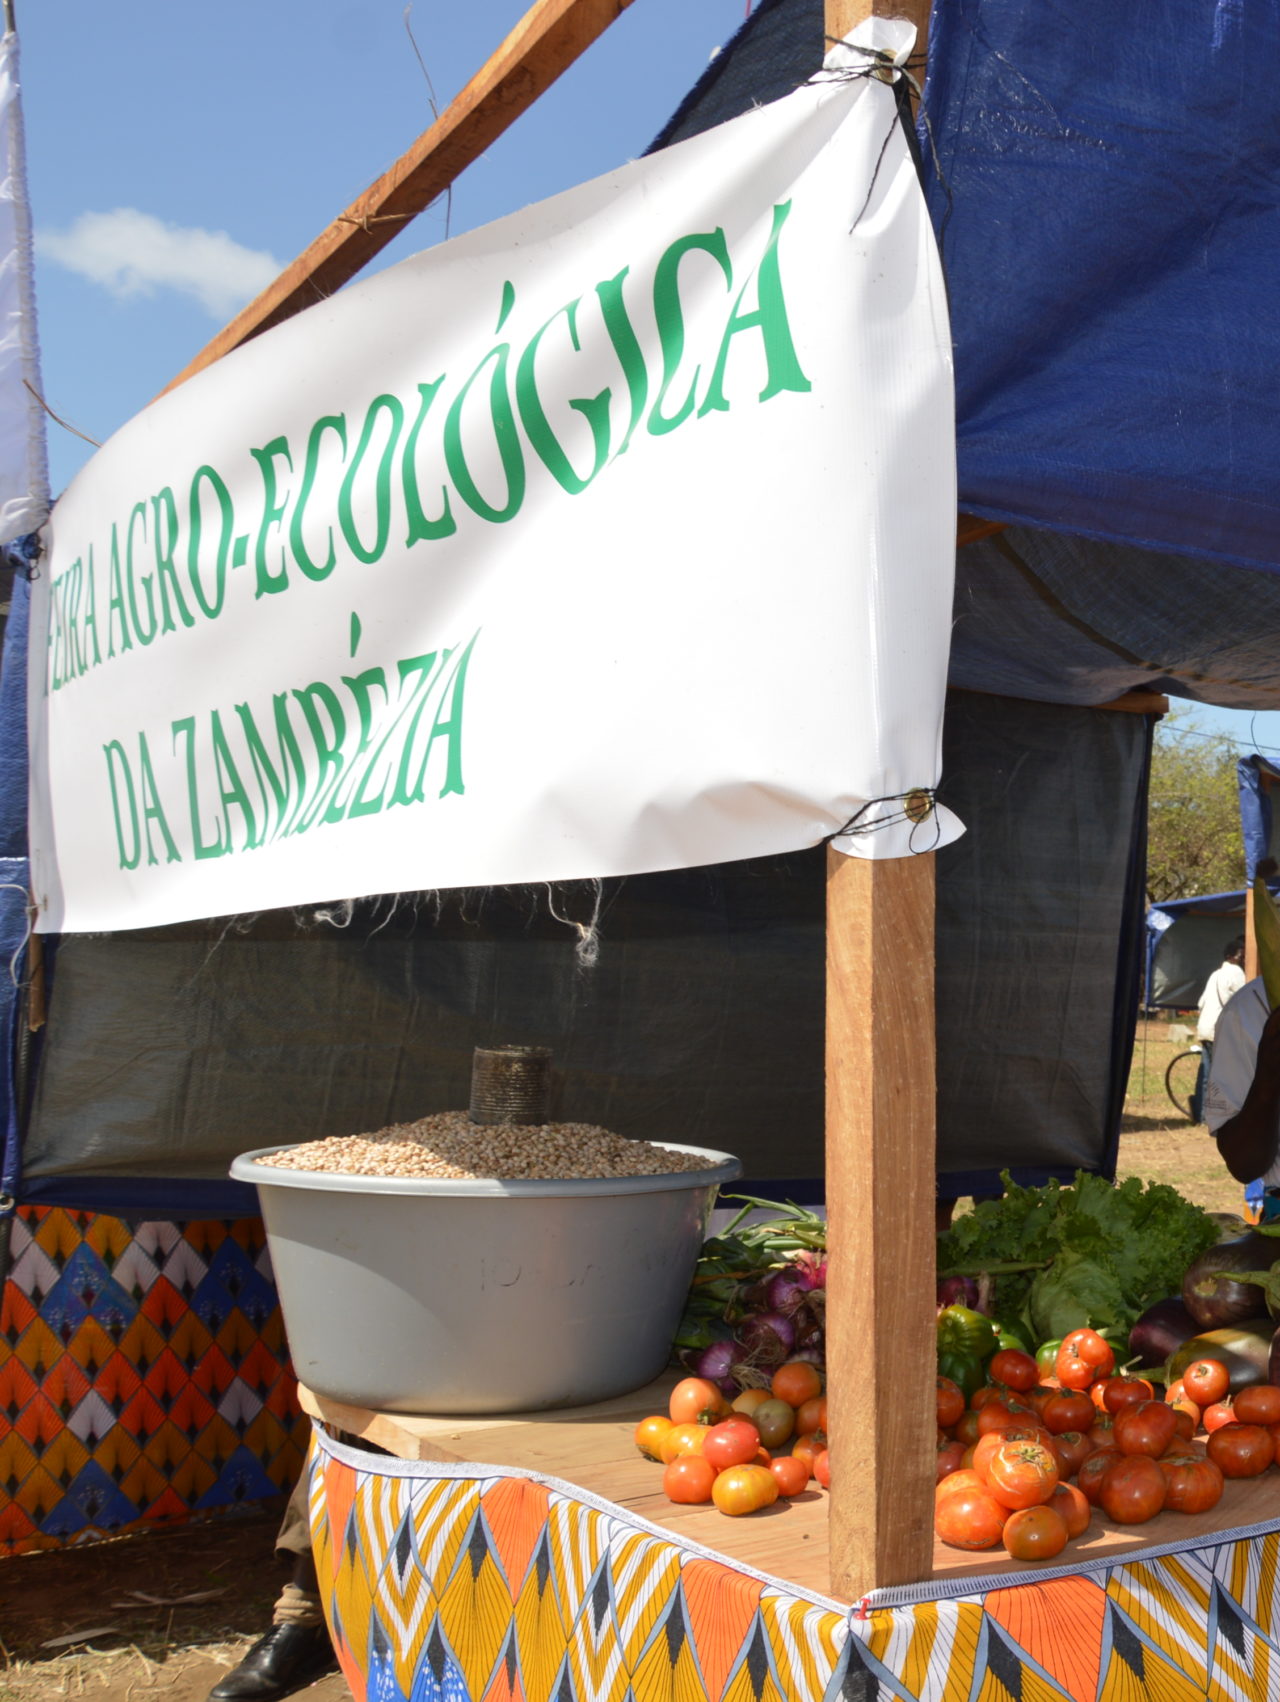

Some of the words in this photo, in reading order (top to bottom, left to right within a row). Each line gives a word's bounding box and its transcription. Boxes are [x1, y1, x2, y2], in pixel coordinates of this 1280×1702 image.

[106, 198, 812, 659] AGRO-ECOLÓGICA
[103, 731, 182, 870] DA
[172, 611, 482, 860] ZAMBÉZIA
